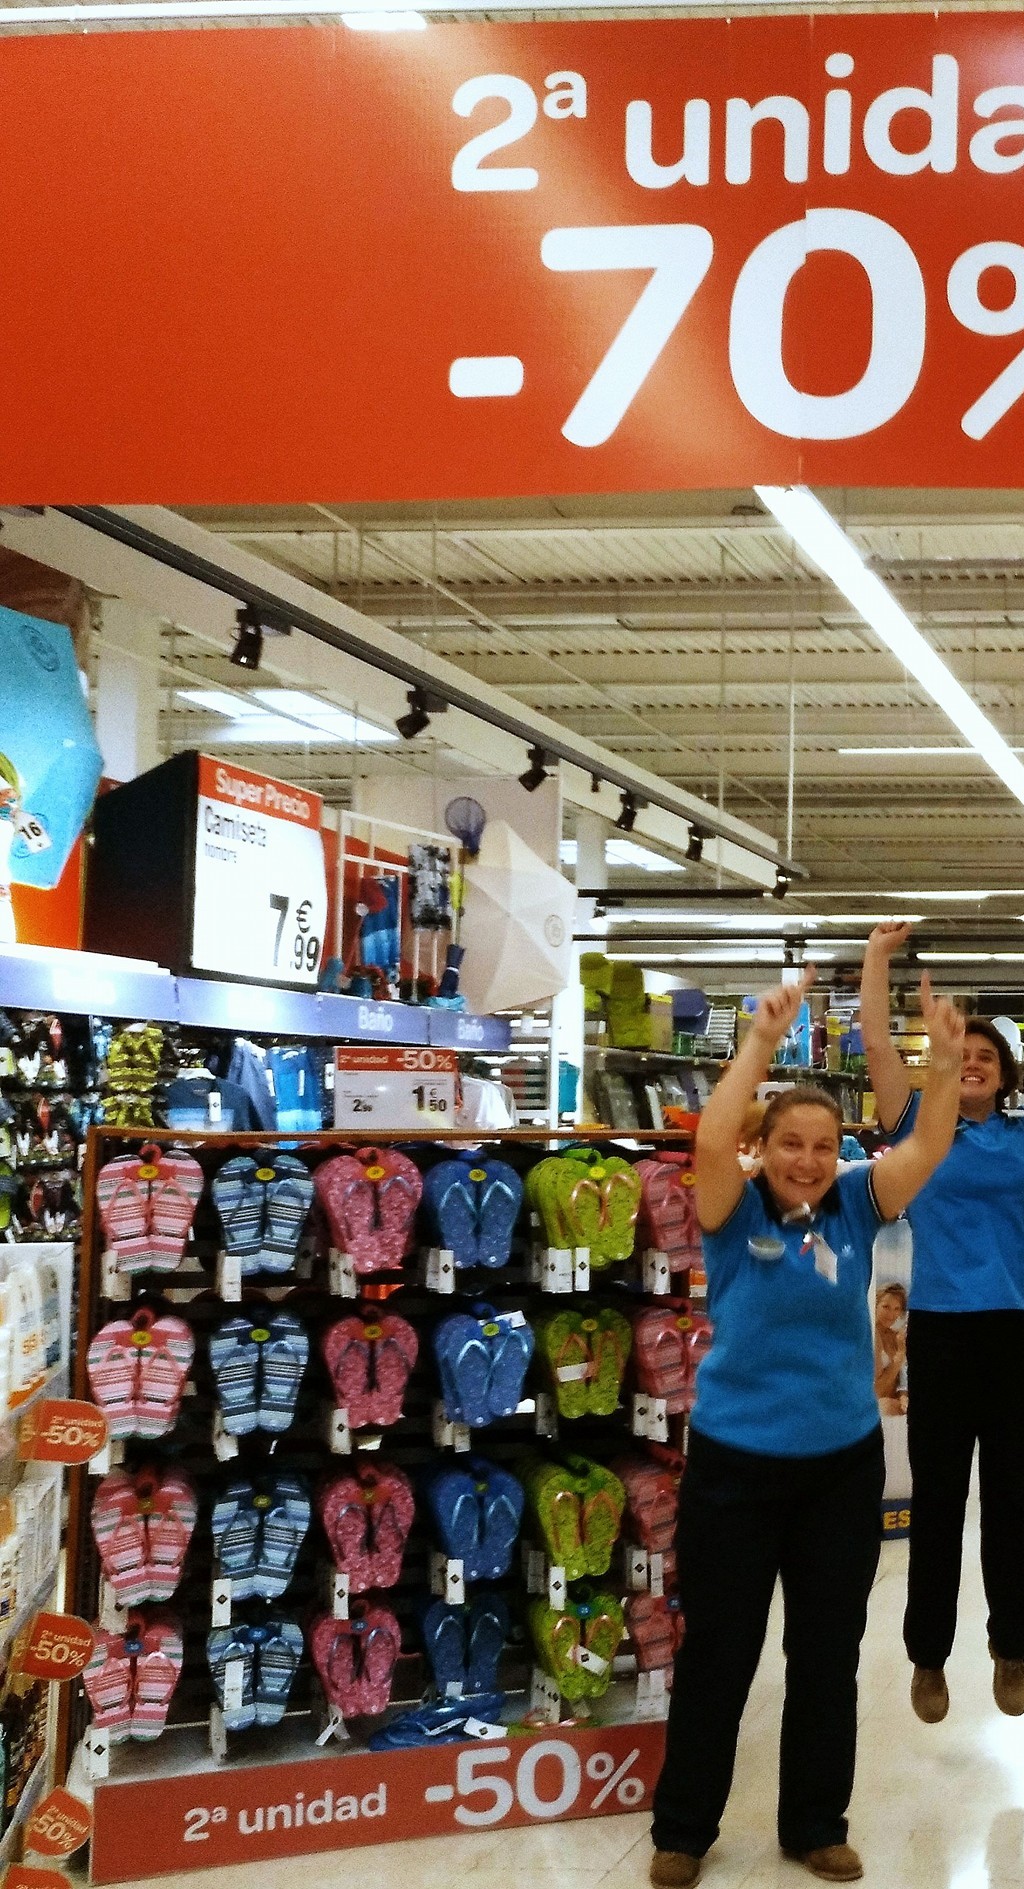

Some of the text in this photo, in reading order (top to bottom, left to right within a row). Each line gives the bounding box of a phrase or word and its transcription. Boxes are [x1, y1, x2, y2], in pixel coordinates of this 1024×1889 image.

[451, 70, 587, 192] 2ª
[215, 767, 311, 820] Super Precio
[204, 805, 267, 848] Camiseta
[358, 1005, 394, 1032] Baño
[396, 1049, 453, 1070] -50%
[40, 1425, 101, 1447] -50%
[30, 1640, 86, 1668] -50%
[53, 1633, 92, 1648] unidad
[182, 1739, 646, 1842] 2ª unidad -50%
